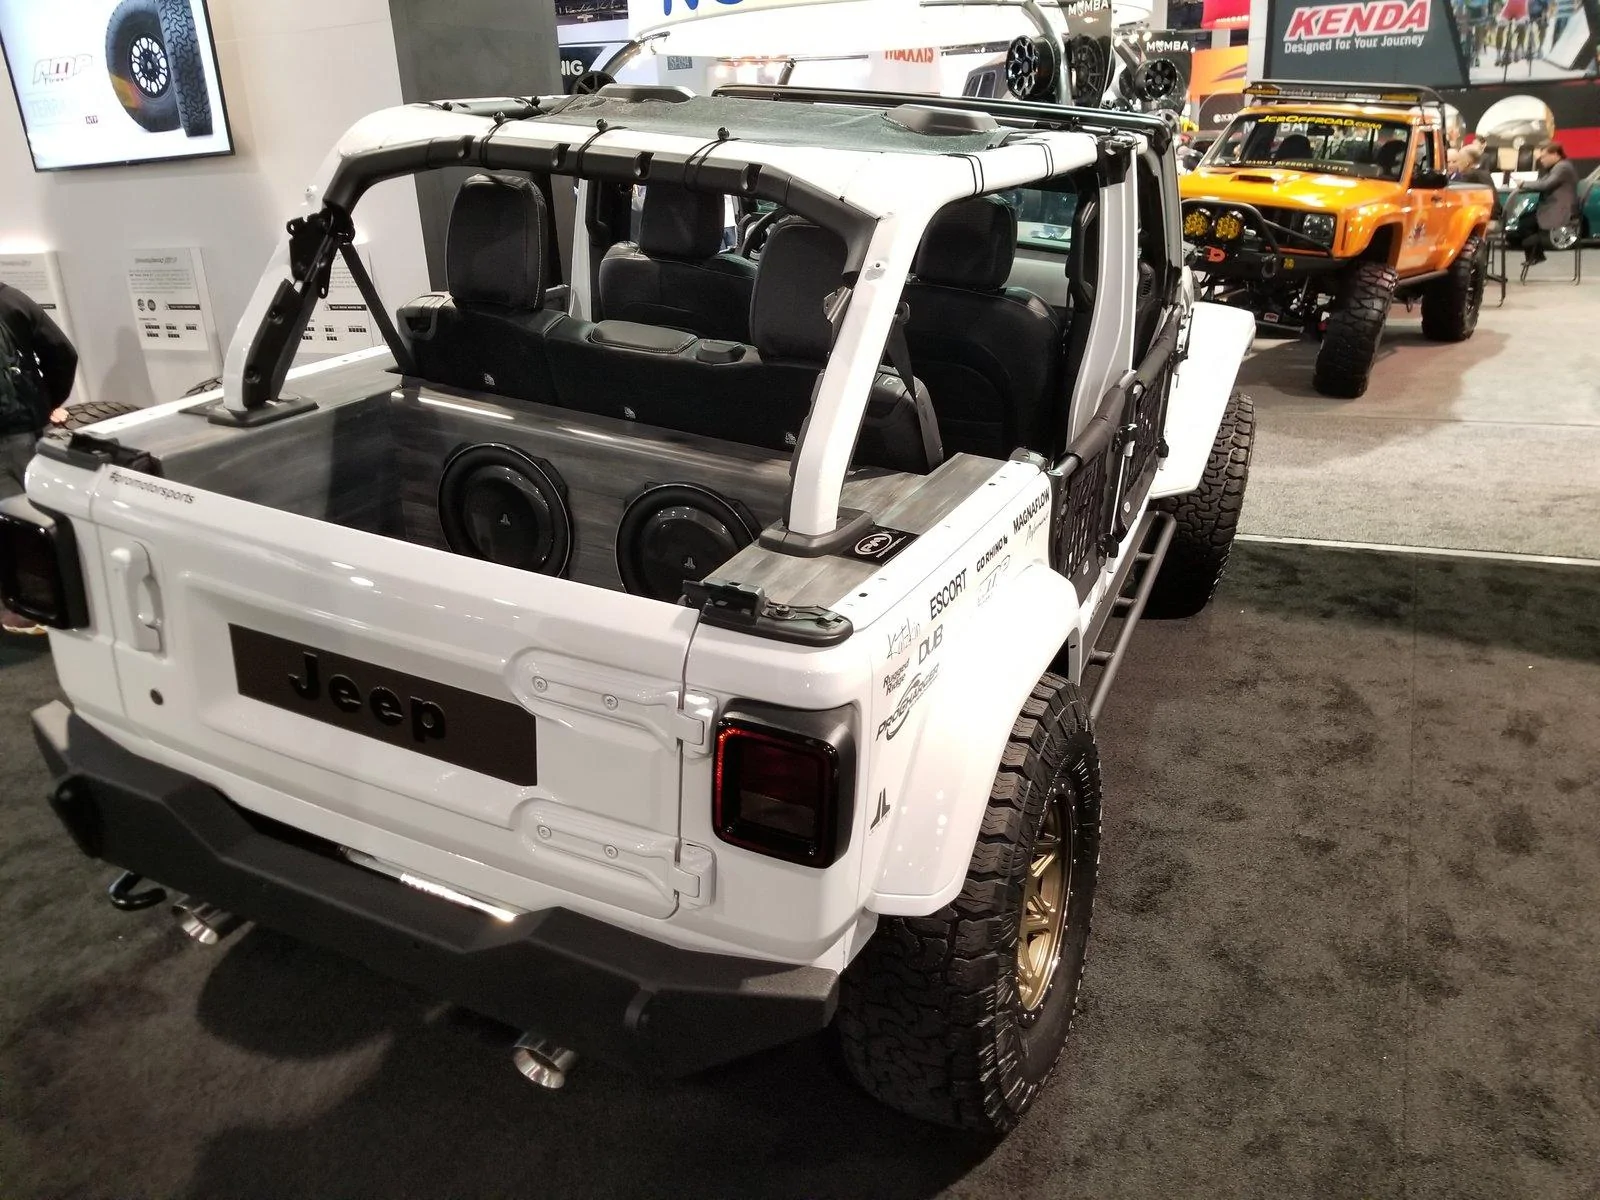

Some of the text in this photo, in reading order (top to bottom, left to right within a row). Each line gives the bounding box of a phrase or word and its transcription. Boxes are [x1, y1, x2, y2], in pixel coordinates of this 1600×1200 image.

[1283, 0, 1432, 41] KENDA
[1284, 34, 1425, 55] Designed for Your Journey
[1013, 486, 1050, 535] MAGNAFLOW
[930, 567, 967, 621] ESCORT
[918, 623, 944, 666] DUB
[287, 651, 447, 743] Jeep
